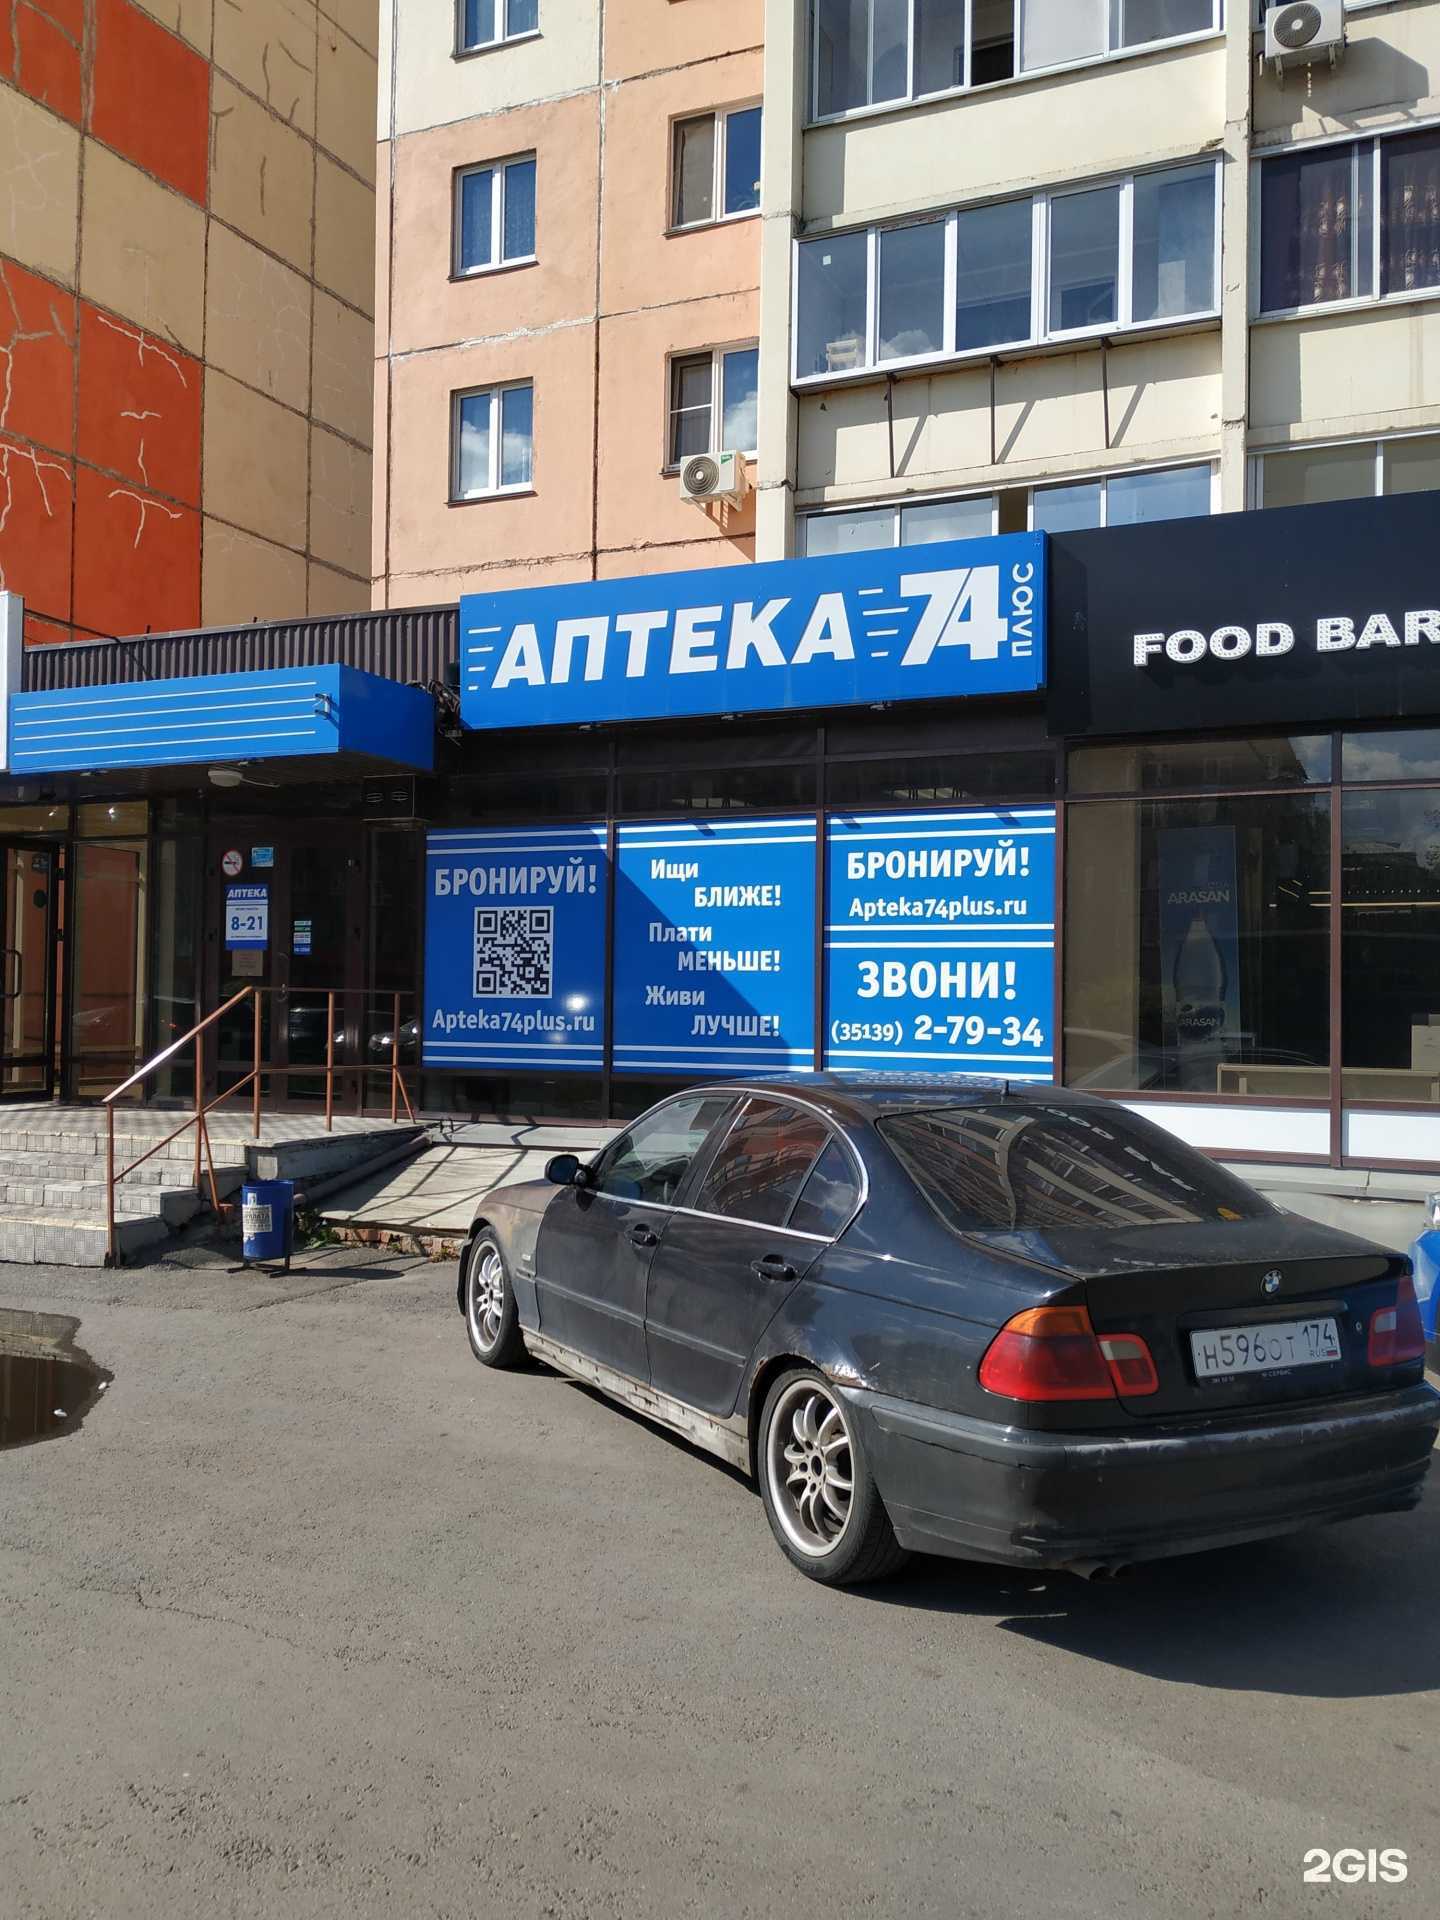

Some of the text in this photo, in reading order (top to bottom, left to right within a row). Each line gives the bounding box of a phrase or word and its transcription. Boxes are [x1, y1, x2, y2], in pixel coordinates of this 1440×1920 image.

[1011, 561, 1034, 658] ПЛЮС
[491, 564, 1008, 689] АПТЕКА 74
[1133, 609, 1440, 667] FOOD BAR
[651, 859, 699, 883] Ищи
[847, 839, 1030, 880] БРОНИРУЙ!
[434, 856, 598, 897] БРОНИРУЙ!
[227, 888, 268, 898] АПТЕКА
[694, 885, 782, 908] БЛИЖЕ!
[1168, 890, 1230, 904] ARASAN
[849, 895, 1027, 921] Apteka74plus.ru
[231, 915, 263, 931] 8-21
[648, 922, 713, 943] Плати
[677, 950, 781, 972] МЕНЬШЕ!
[856, 960, 1017, 1000] ЗВОНИ!
[645, 985, 705, 1006] Живи
[432, 1008, 596, 1035] Apteka74plus.ru
[690, 1015, 781, 1037] ЛУЧШЕ!
[831, 1014, 1044, 1048] (35139) 2-79-34
[1309, 1349, 1328, 1358] RUS
